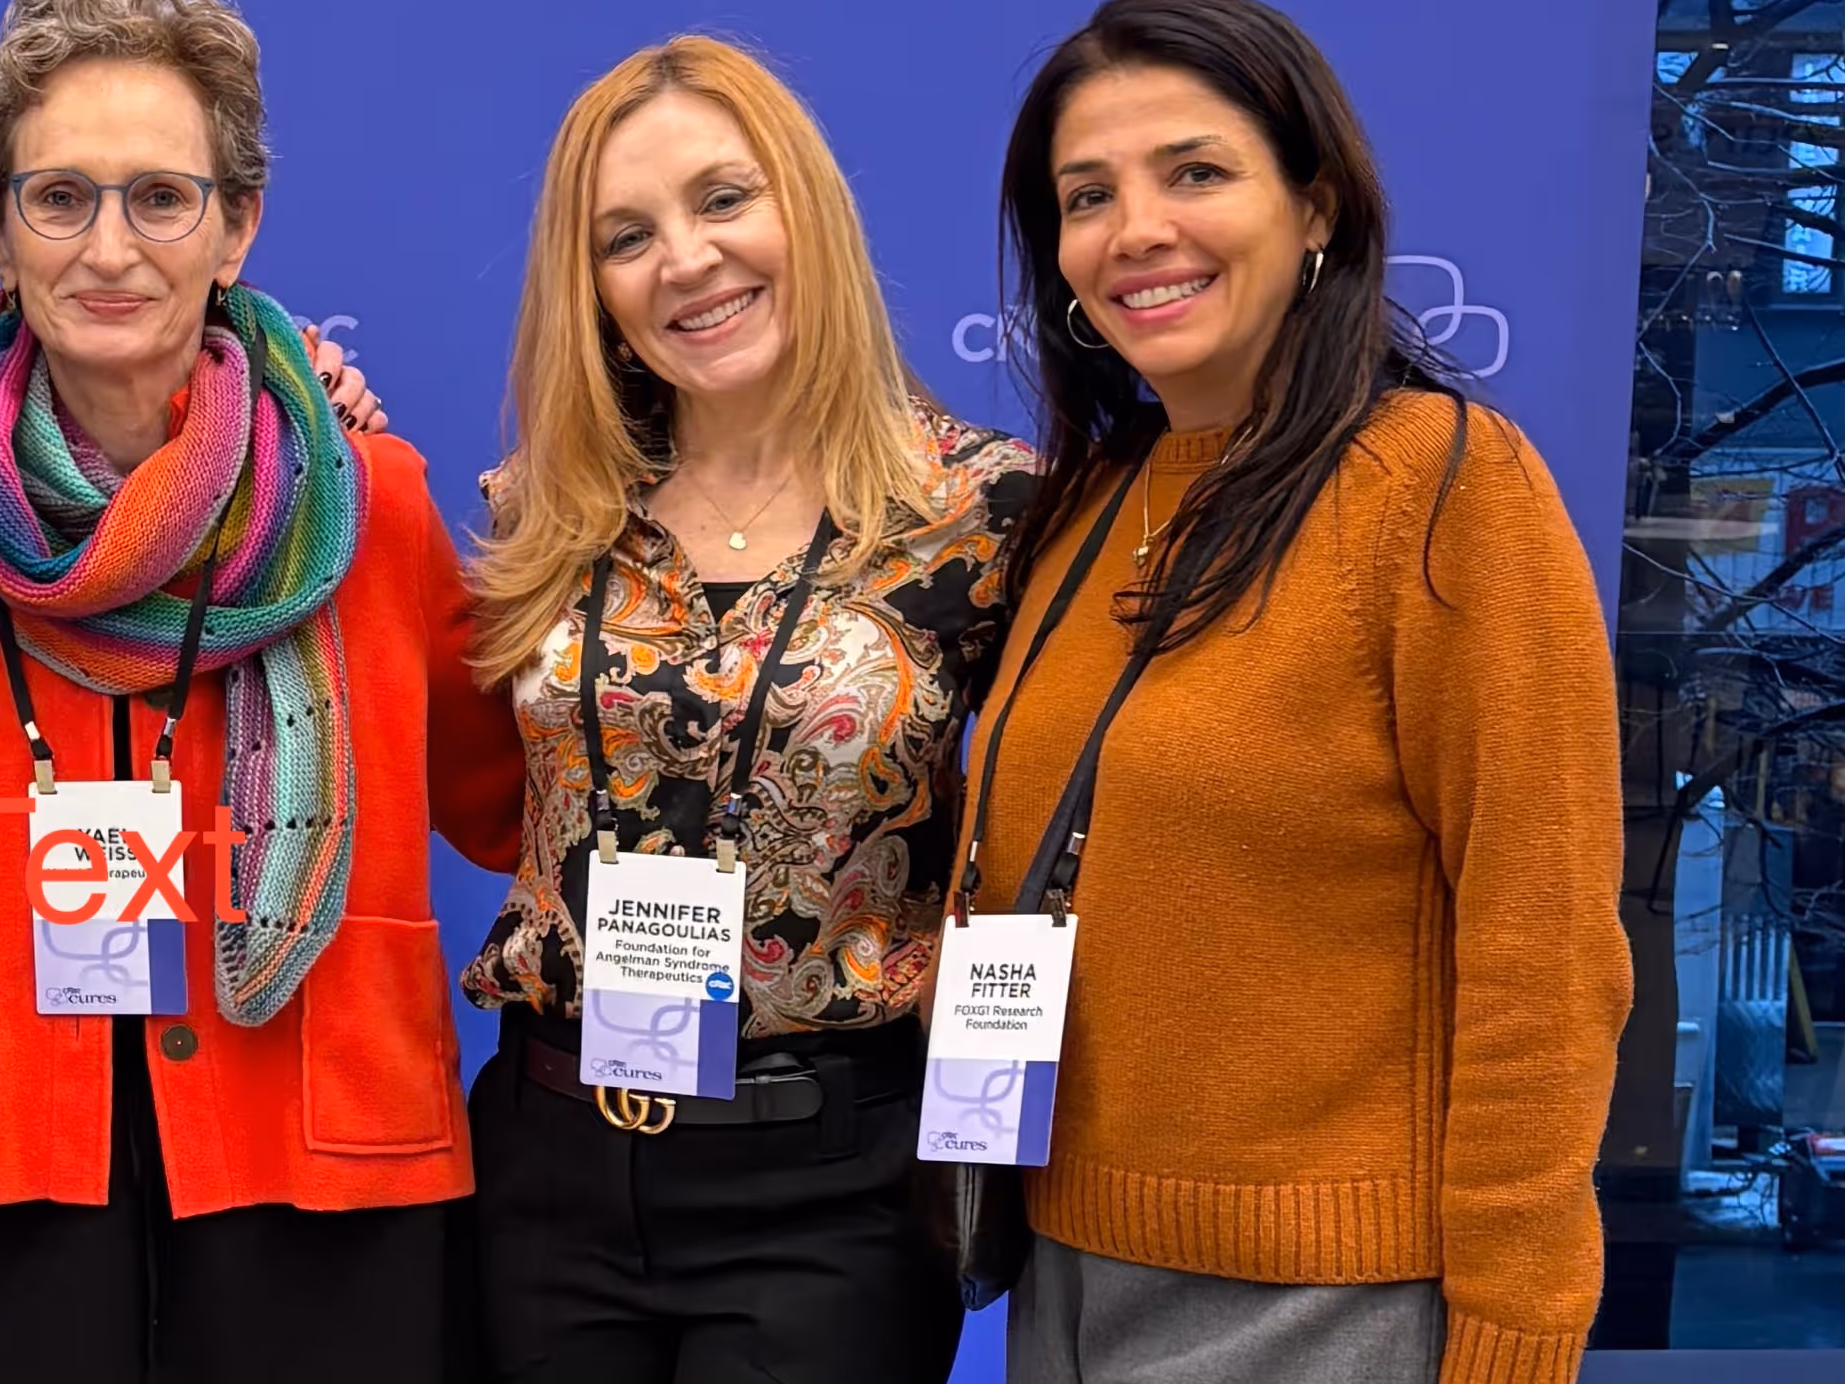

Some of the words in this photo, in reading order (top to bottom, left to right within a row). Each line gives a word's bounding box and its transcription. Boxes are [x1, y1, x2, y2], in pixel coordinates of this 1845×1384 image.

[75, 846, 137, 861] WISS
[608, 899, 721, 924] JENNIFER
[598, 917, 731, 942] PANAGOULIAS
[615, 939, 688, 956] Foundation
[692, 945, 710, 957] for
[596, 951, 660, 968] Angelman
[664, 957, 730, 973] Syndrome
[621, 966, 703, 984] Therapeutics
[970, 964, 1036, 981] NASHA
[971, 983, 1031, 998] FITTER
[954, 1005, 990, 1017] FOXG1
[993, 1006, 1043, 1017] Research
[966, 1019, 1028, 1031] Foundation
[612, 1068, 662, 1081] cures
[946, 1138, 987, 1151] cures
